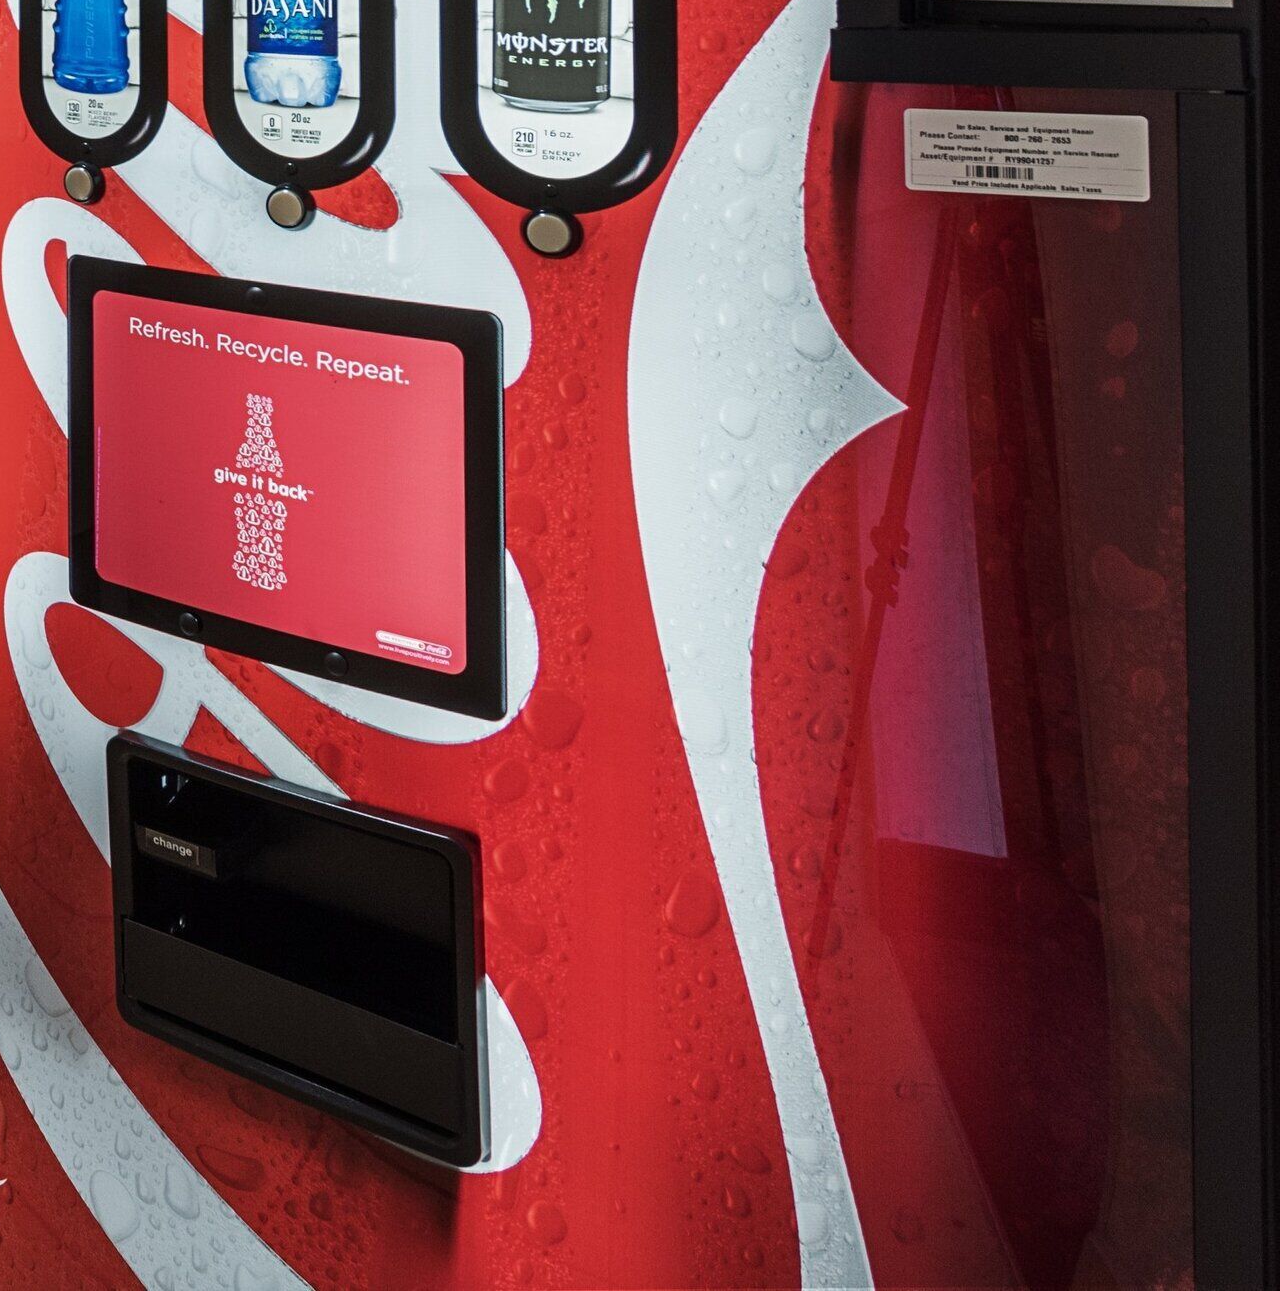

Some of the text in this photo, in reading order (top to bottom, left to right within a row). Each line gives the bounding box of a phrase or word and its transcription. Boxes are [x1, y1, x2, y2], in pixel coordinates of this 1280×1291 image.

[497, 31, 608, 56] MONSTER
[509, 55, 596, 67] ENERGY
[270, 118, 274, 127] 0
[291, 113, 301, 122] 20
[516, 131, 534, 143] 210
[947, 132, 980, 140] Contact:
[129, 317, 410, 386] Refresh. Recycle. Repeat.
[214, 467, 247, 487] give
[252, 474, 263, 490] it
[152, 834, 193, 858] change
